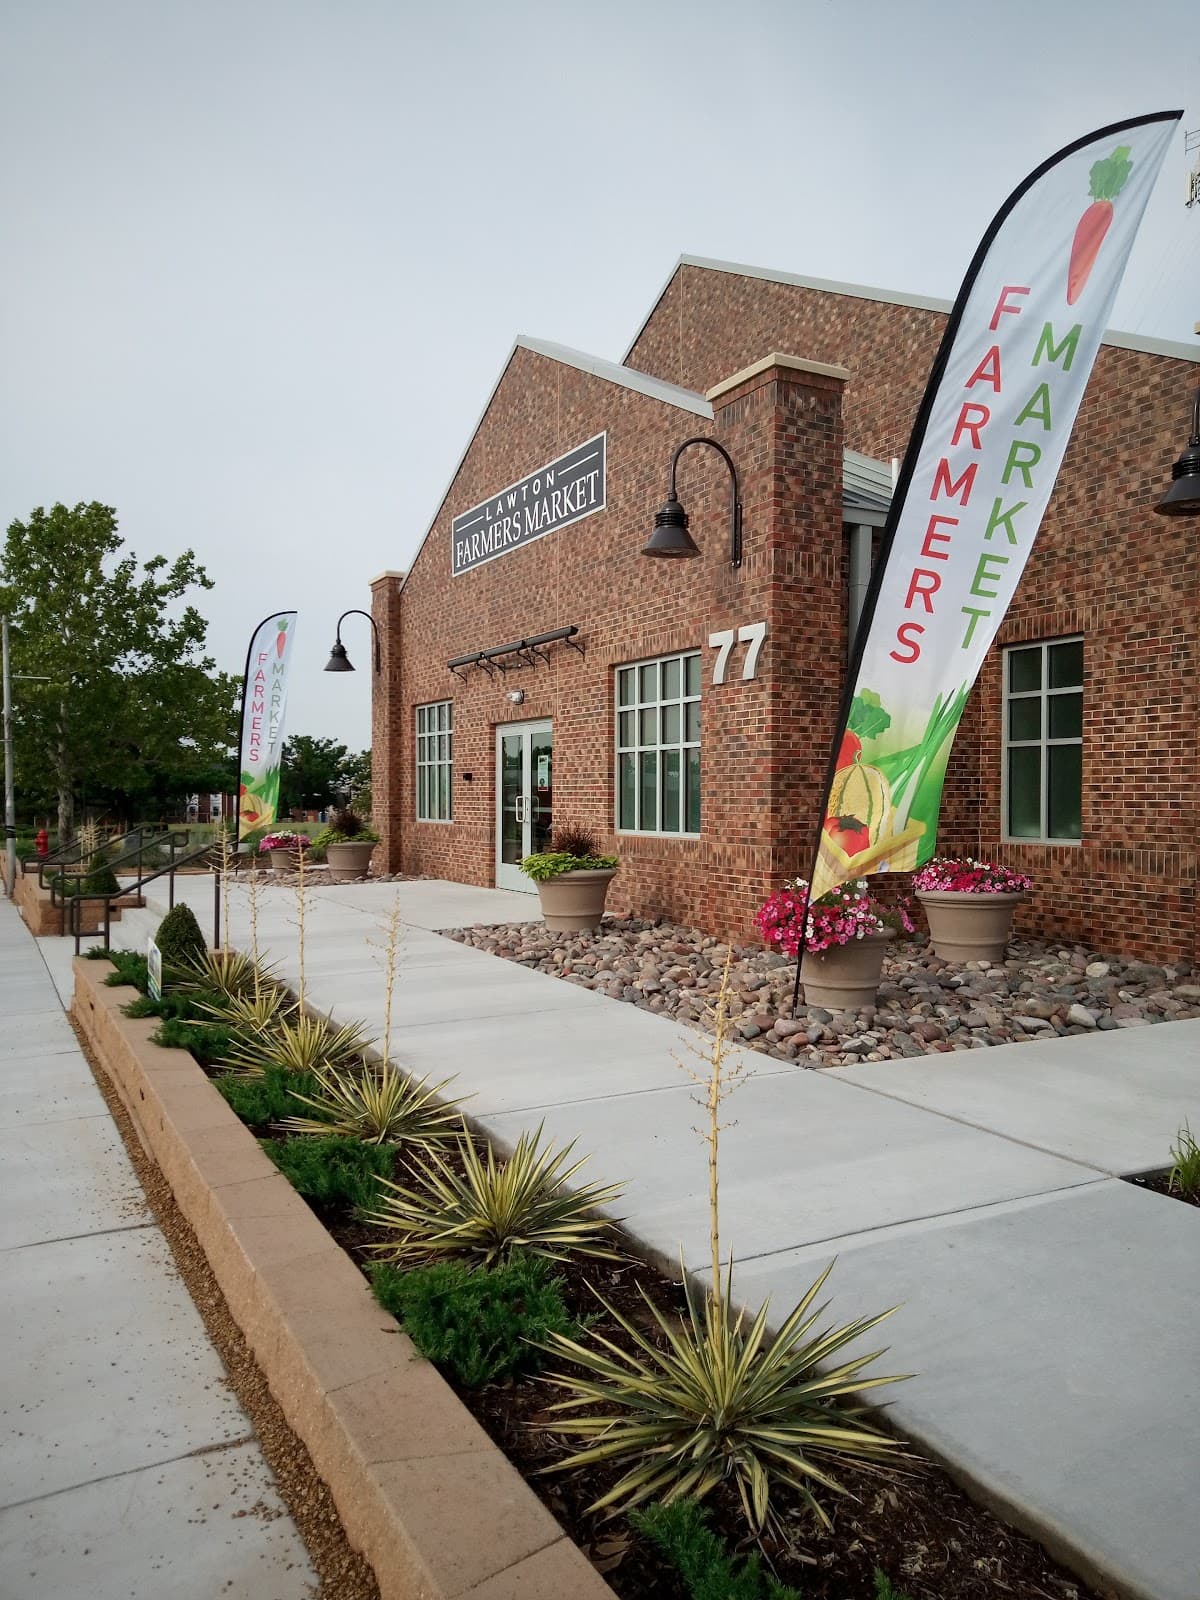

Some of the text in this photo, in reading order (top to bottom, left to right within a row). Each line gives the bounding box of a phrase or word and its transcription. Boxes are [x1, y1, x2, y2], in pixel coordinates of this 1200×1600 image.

[455, 469, 599, 568] FARMERS MARKET
[485, 470, 555, 522] LAWTON
[889, 285, 1031, 664] FARMERS
[960, 321, 1083, 650] MARKET
[708, 621, 767, 685] 77
[249, 653, 269, 762] FARMERS
[267, 662, 285, 754] MARKET
